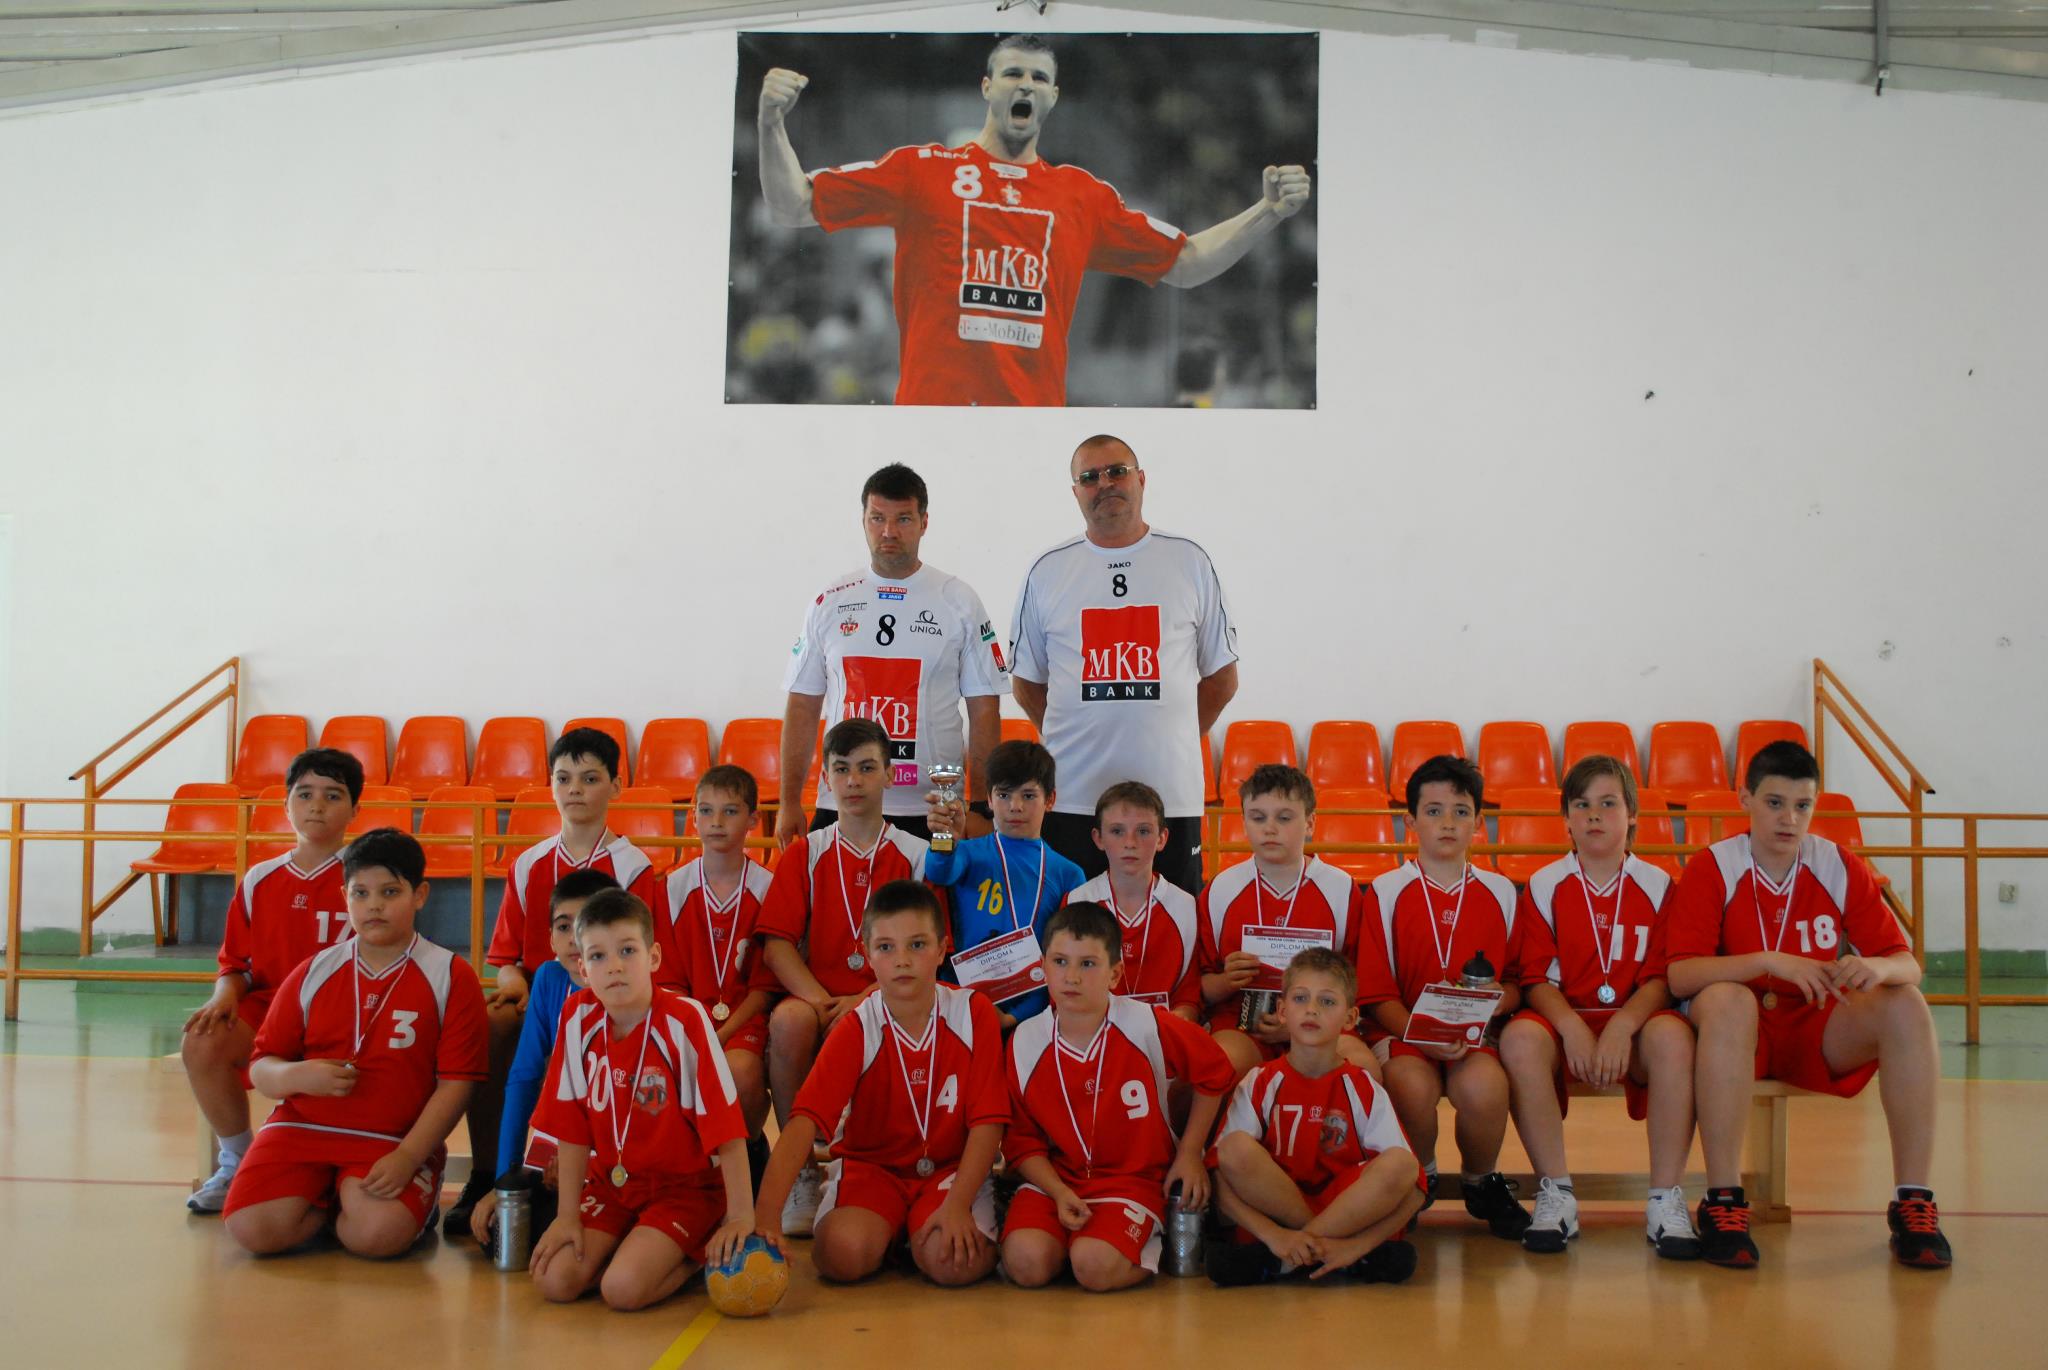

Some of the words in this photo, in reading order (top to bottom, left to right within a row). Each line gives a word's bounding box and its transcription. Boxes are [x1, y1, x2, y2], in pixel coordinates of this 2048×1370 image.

[952, 164, 983, 199] 8
[972, 245, 1039, 289] MKB
[972, 288, 1036, 308] BANK
[1107, 561, 1131, 569] JAKO
[1112, 573, 1128, 598] 8
[876, 614, 896, 646] 8
[909, 625, 943, 637] UNIQA
[1088, 641, 1153, 681] MKB
[1089, 685, 1153, 697] BANK
[849, 696, 910, 737] MKB
[977, 879, 1004, 915] 16
[316, 911, 353, 944] 17
[1608, 924, 1649, 962] 11
[1796, 914, 1837, 953] 18
[388, 1010, 418, 1049] 3
[936, 1073, 958, 1113] 4
[1120, 1079, 1150, 1120] 9
[1273, 1104, 1303, 1157] 17
